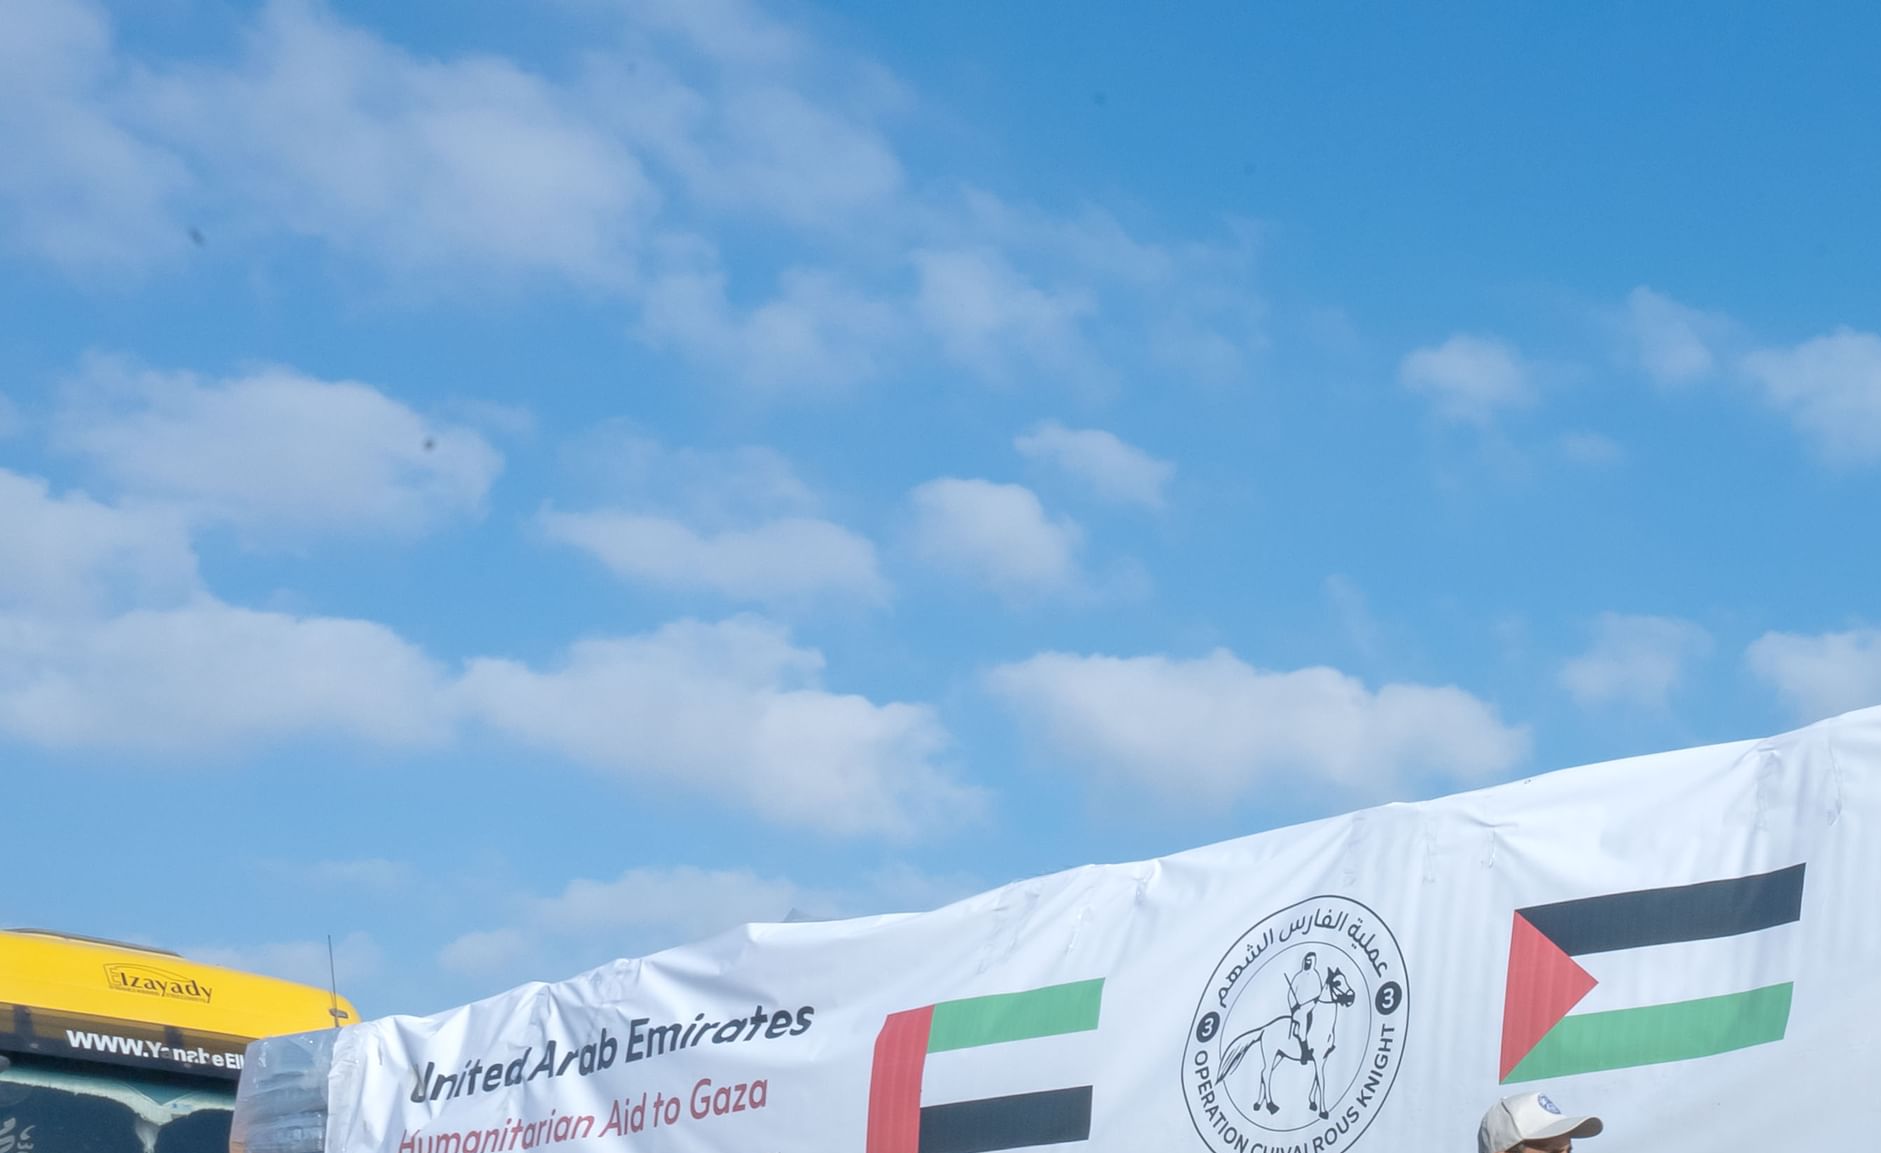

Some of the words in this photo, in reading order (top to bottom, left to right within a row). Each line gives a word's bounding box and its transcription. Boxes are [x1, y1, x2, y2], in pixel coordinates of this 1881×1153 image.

[1279, 908, 1349, 943] الفارس
[1348, 917, 1388, 978] عملية
[410, 1047, 532, 1103] United
[528, 1027, 617, 1080] Arab
[625, 1005, 815, 1063] Emirates
[1356, 1023, 1396, 1108] KNIGHT
[598, 1092, 646, 1137] Aid
[652, 1093, 681, 1127] to
[689, 1077, 768, 1120] Gaza
